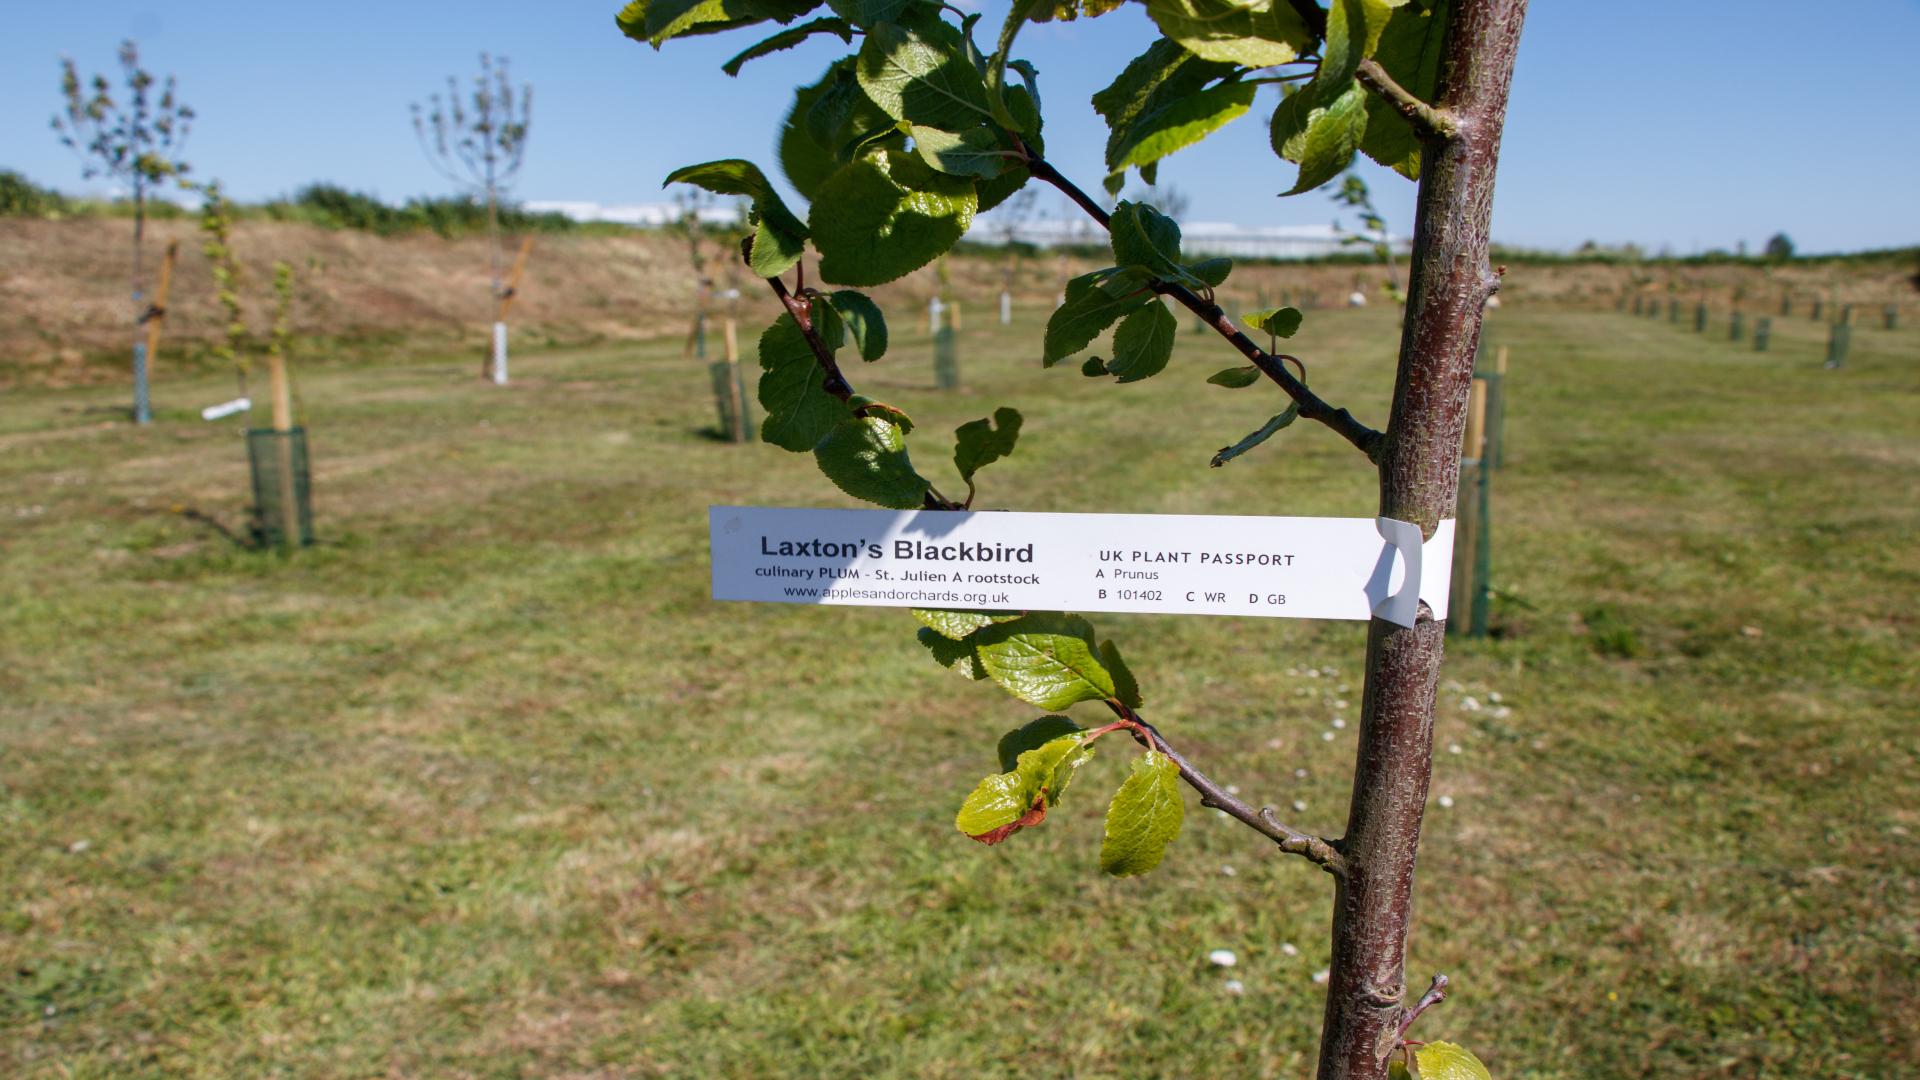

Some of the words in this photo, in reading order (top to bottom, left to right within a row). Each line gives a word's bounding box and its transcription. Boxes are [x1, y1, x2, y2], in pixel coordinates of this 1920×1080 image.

[894, 540, 1033, 563] Blackbird
[1099, 550, 1123, 562] UK
[1132, 551, 1192, 564] PLANT
[1201, 552, 1295, 566] PASSPORT
[755, 566, 814, 580] culinary
[819, 568, 860, 580] PLUM
[875, 569, 895, 581] St.
[900, 570, 947, 583] Julien
[952, 572, 963, 583] A
[968, 572, 1040, 585] rootstock
[1095, 569, 1104, 578] A
[1114, 569, 1159, 580] Prunus
[784, 585, 1009, 605] www.applesandorchards.org.uk
[1098, 589, 1107, 599] B
[1116, 589, 1162, 601] 101402
[1186, 591, 1195, 602] C
[1205, 592, 1226, 603] WR
[1249, 593, 1258, 604] D
[1267, 594, 1286, 605] GB
